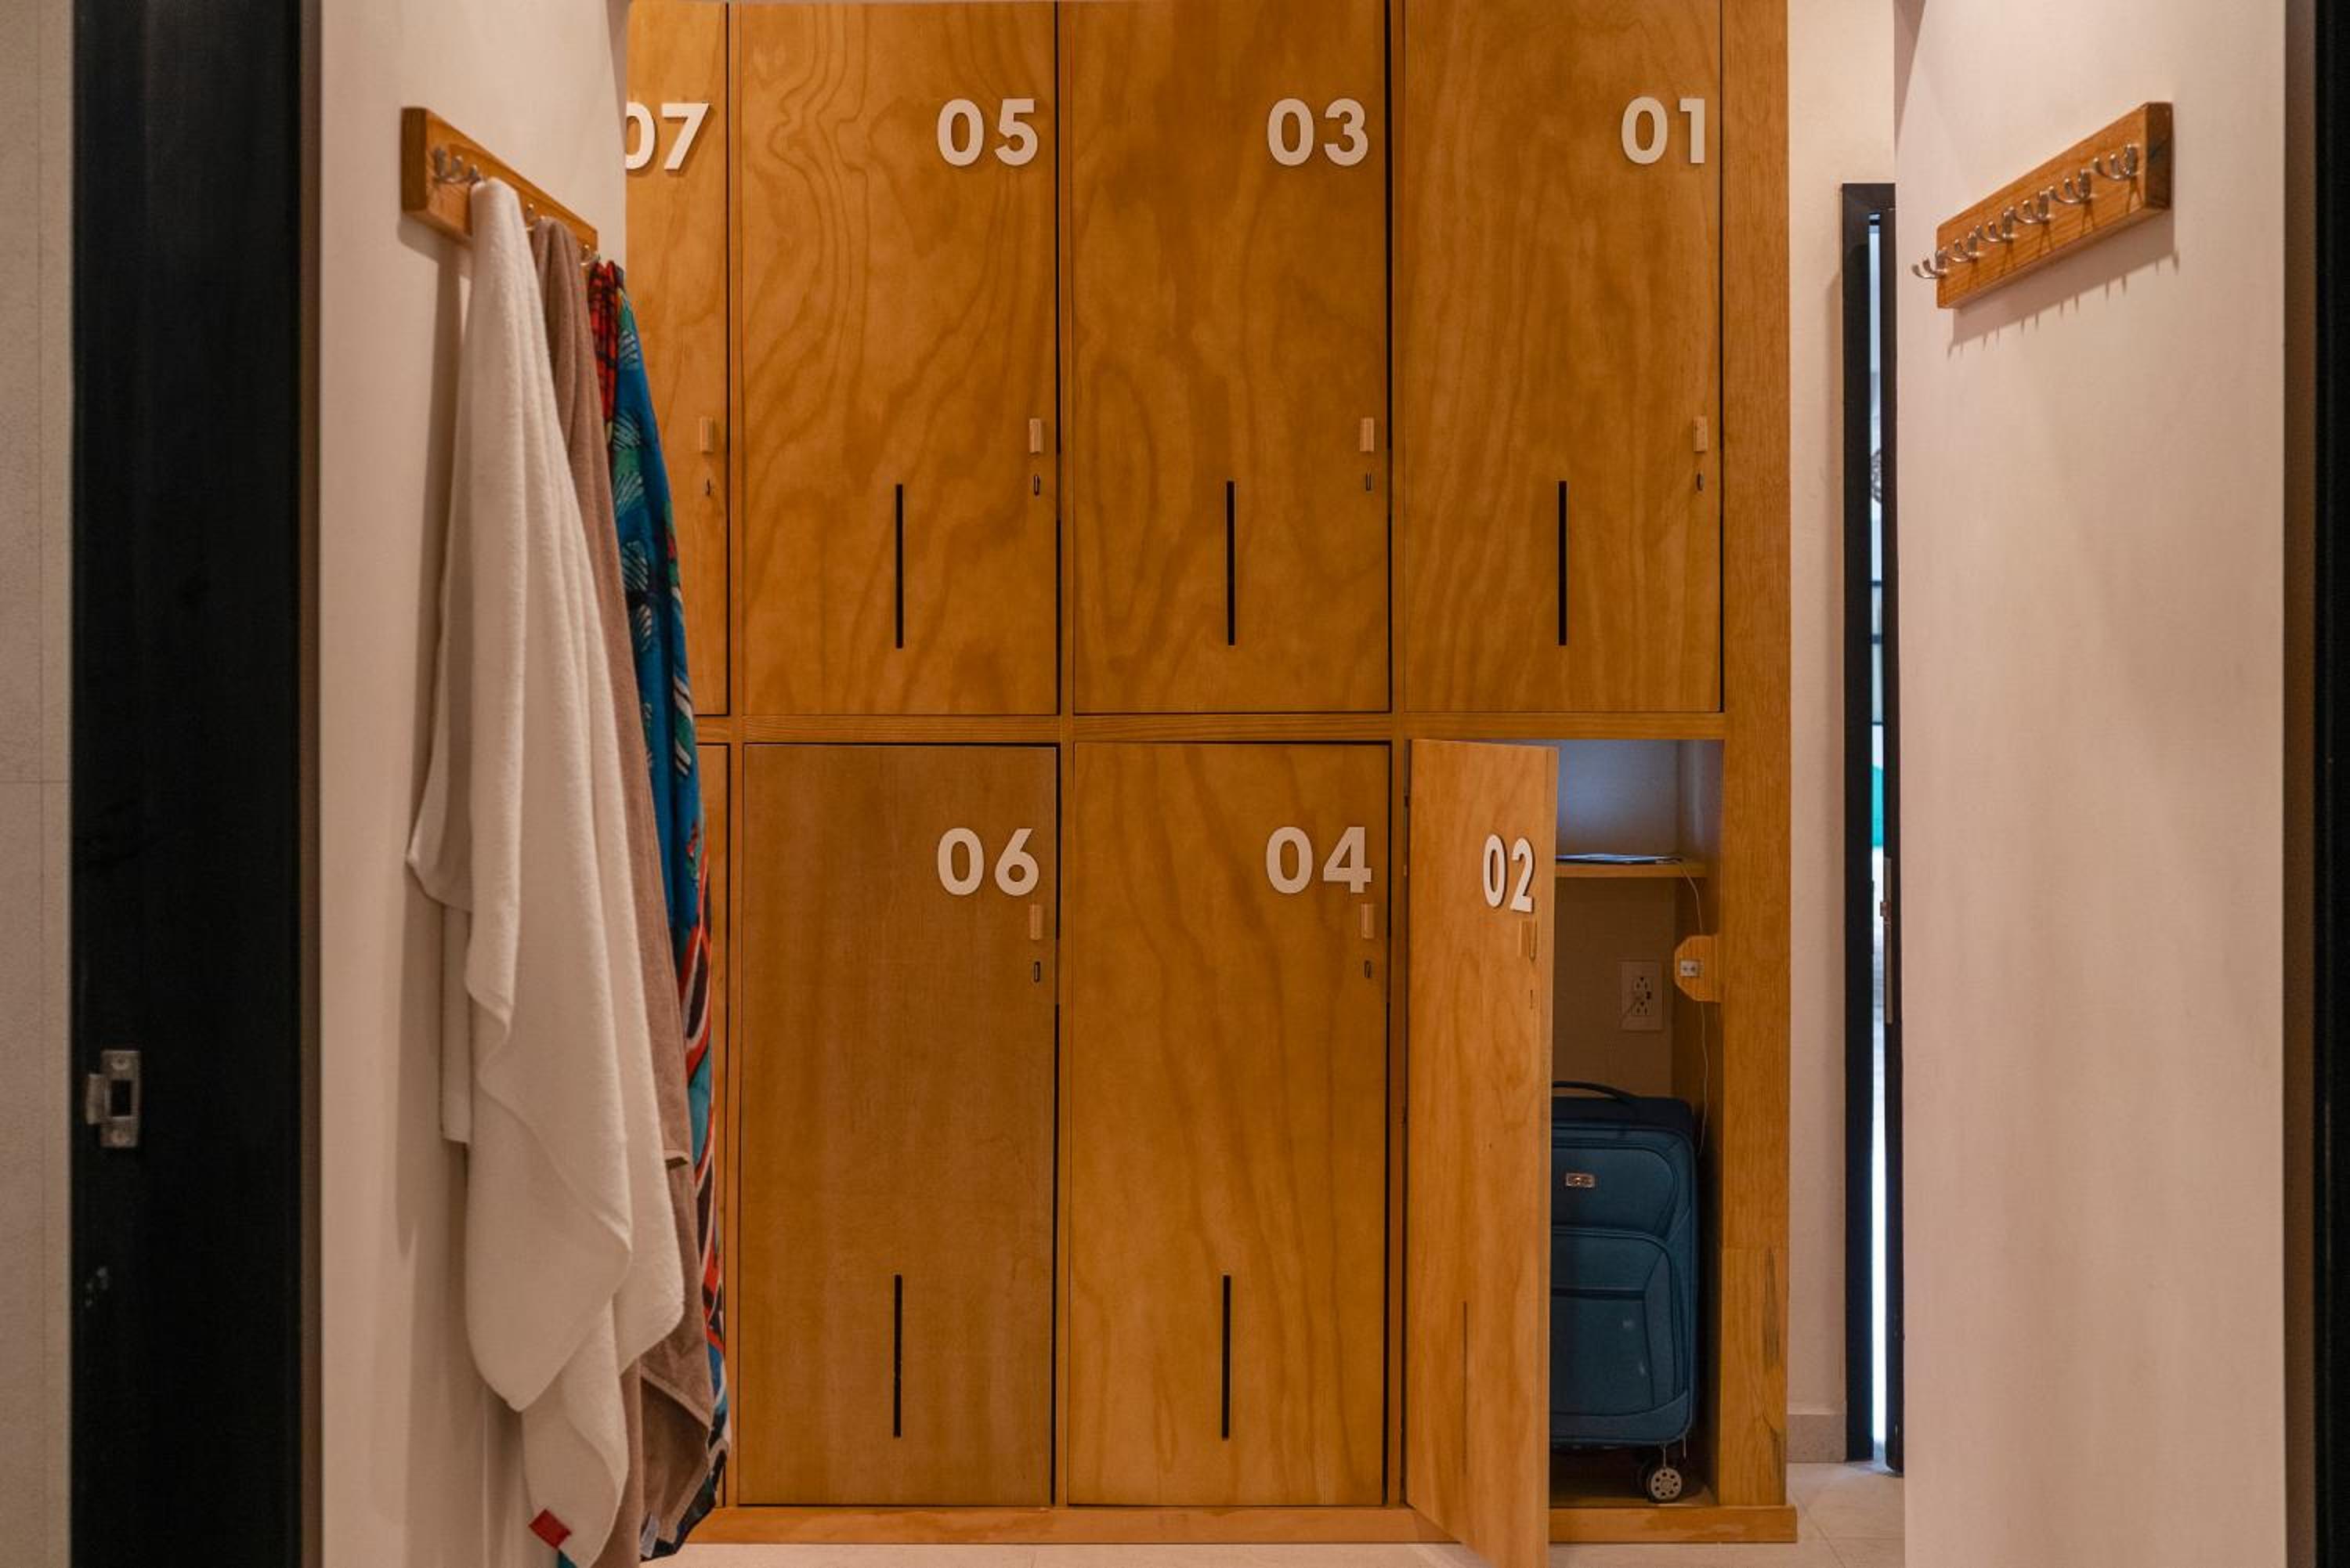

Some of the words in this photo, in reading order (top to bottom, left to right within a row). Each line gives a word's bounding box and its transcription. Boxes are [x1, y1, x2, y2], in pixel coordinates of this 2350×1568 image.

[626, 101, 710, 170] 07
[938, 99, 1038, 166] 05
[1267, 99, 1368, 166] 03
[1622, 97, 1706, 164] 01
[938, 828, 1039, 896] 06
[1267, 826, 1371, 894] 04
[1482, 833, 1534, 913] 02
